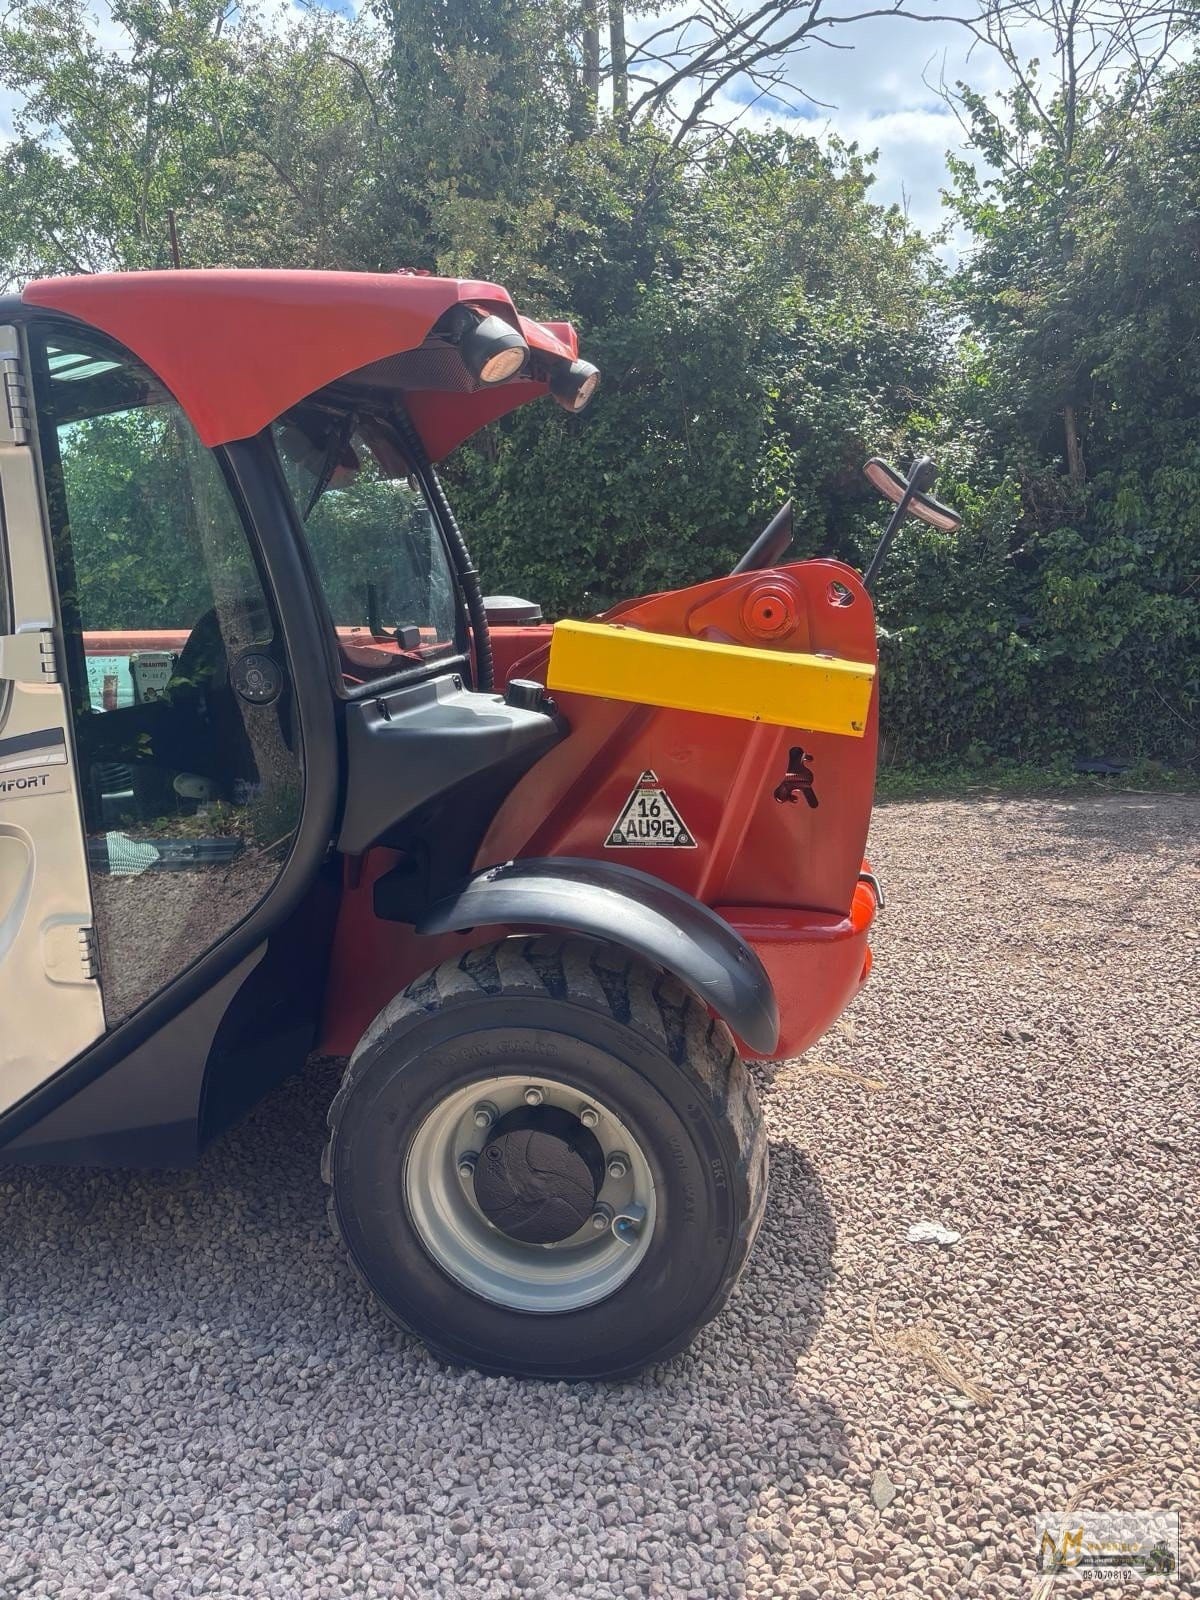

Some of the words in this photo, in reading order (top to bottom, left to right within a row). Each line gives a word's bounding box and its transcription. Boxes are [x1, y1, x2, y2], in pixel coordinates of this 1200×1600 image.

[637, 798, 661, 818] 16
[626, 819, 675, 838] AU9G
[711, 1159, 728, 1189] BKT
